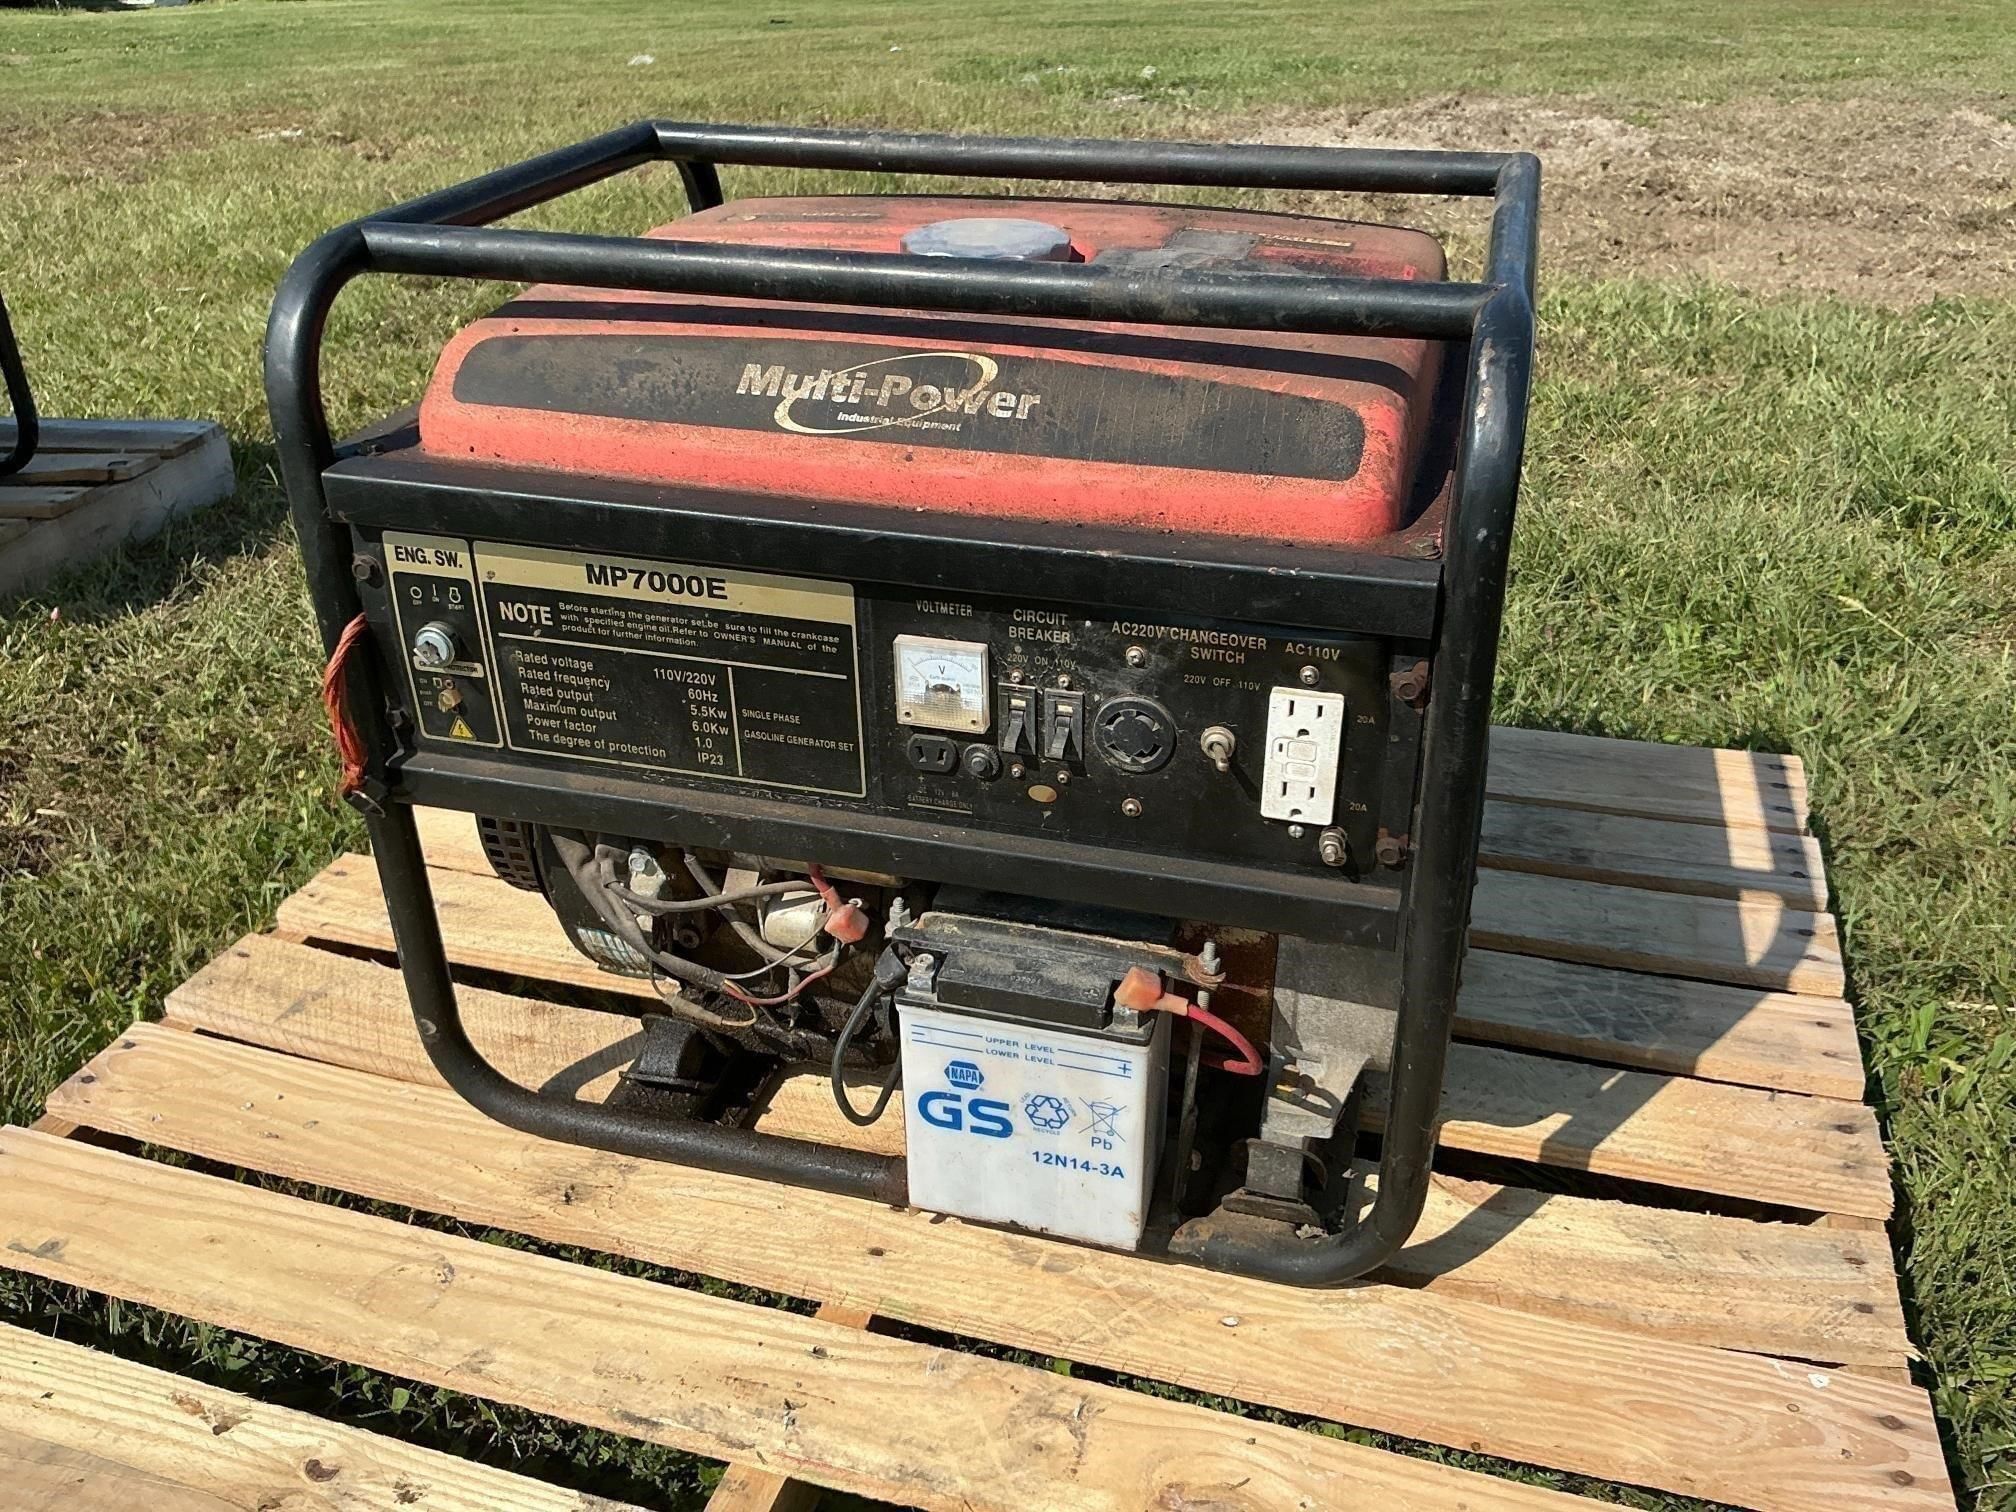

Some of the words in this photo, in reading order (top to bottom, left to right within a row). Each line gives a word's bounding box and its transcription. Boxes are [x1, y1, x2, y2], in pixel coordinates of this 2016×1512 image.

[736, 362, 1041, 420] Multi-Power
[837, 411, 895, 425] Industrial
[896, 414, 962, 432] Equipment
[394, 545, 432, 564] ENG.
[434, 550, 463, 568] SW.
[585, 563, 728, 600] MP7000E
[499, 601, 554, 626] NOTE
[916, 599, 973, 617] VOLTMETER
[1012, 608, 1068, 626] CIRCUIT
[558, 602, 589, 613] Before
[590, 606, 626, 619] starting
[627, 611, 643, 620] the
[644, 612, 689, 625] generator
[725, 623, 746, 632] sure
[747, 626, 758, 634] to
[759, 626, 772, 635] fill
[774, 628, 789, 638] the
[791, 631, 841, 644] crankcase
[560, 614, 580, 622] with
[584, 616, 625, 628] specified
[626, 622, 657, 632] engine
[698, 630, 709, 638] to
[713, 631, 756, 644] OWNER'S
[763, 637, 802, 649] MANUAL
[821, 645, 838, 654] the
[562, 624, 597, 635] product
[598, 627, 610, 636] for
[612, 630, 643, 640] further
[645, 635, 699, 647] information.
[1008, 626, 1071, 644] BREAKER
[1169, 627, 1267, 650] CHANGEOVER
[1006, 653, 1029, 664] 220V
[1034, 655, 1049, 666] ON
[1055, 658, 1077, 669] 110V
[1190, 646, 1246, 664] SWITCH
[1284, 642, 1341, 662] AC110V
[516, 650, 548, 664] Rated
[551, 656, 593, 672] voltage
[653, 667, 716, 686] 110V/220V
[938, 665, 946, 675] V
[518, 666, 551, 681] Rated
[553, 670, 610, 691] frequency
[688, 688, 718, 703] 60Hz
[1183, 674, 1206, 685] 220V
[1213, 677, 1232, 688] OFF
[1238, 680, 1261, 692] 110V
[521, 682, 553, 697] Rated
[557, 689, 594, 702] output
[690, 704, 727, 720] 5.5Kw
[523, 698, 577, 715] Maximum
[580, 706, 617, 721] output
[692, 720, 729, 736] 6.0Kw
[741, 708, 771, 721] SINGLE
[773, 713, 801, 725] PHASE
[1357, 715, 1376, 725] 20A
[526, 714, 560, 728] Power
[564, 718, 597, 733] factor
[695, 736, 713, 749] 1.0
[744, 729, 785, 744] GASOLINE
[786, 735, 836, 750] GENERATOR
[838, 742, 855, 752] SET
[528, 729, 550, 742] The
[553, 733, 591, 748] degree
[594, 738, 606, 749] of
[609, 741, 667, 759] protection
[697, 752, 724, 766] IP23
[1349, 802, 1368, 812] 20A
[985, 1036, 1019, 1047] UPPER
[1024, 1042, 1055, 1054] LEVEL
[985, 1048, 1020, 1060] LOWER
[1024, 1054, 1055, 1065] LEVEL
[949, 1067, 978, 1083] NAPA
[917, 1090, 1014, 1139] GS
[1032, 1126, 1061, 1136] RECYCLE
[1091, 1136, 1113, 1151] Pb
[1032, 1150, 1125, 1179] 12N14-3A
